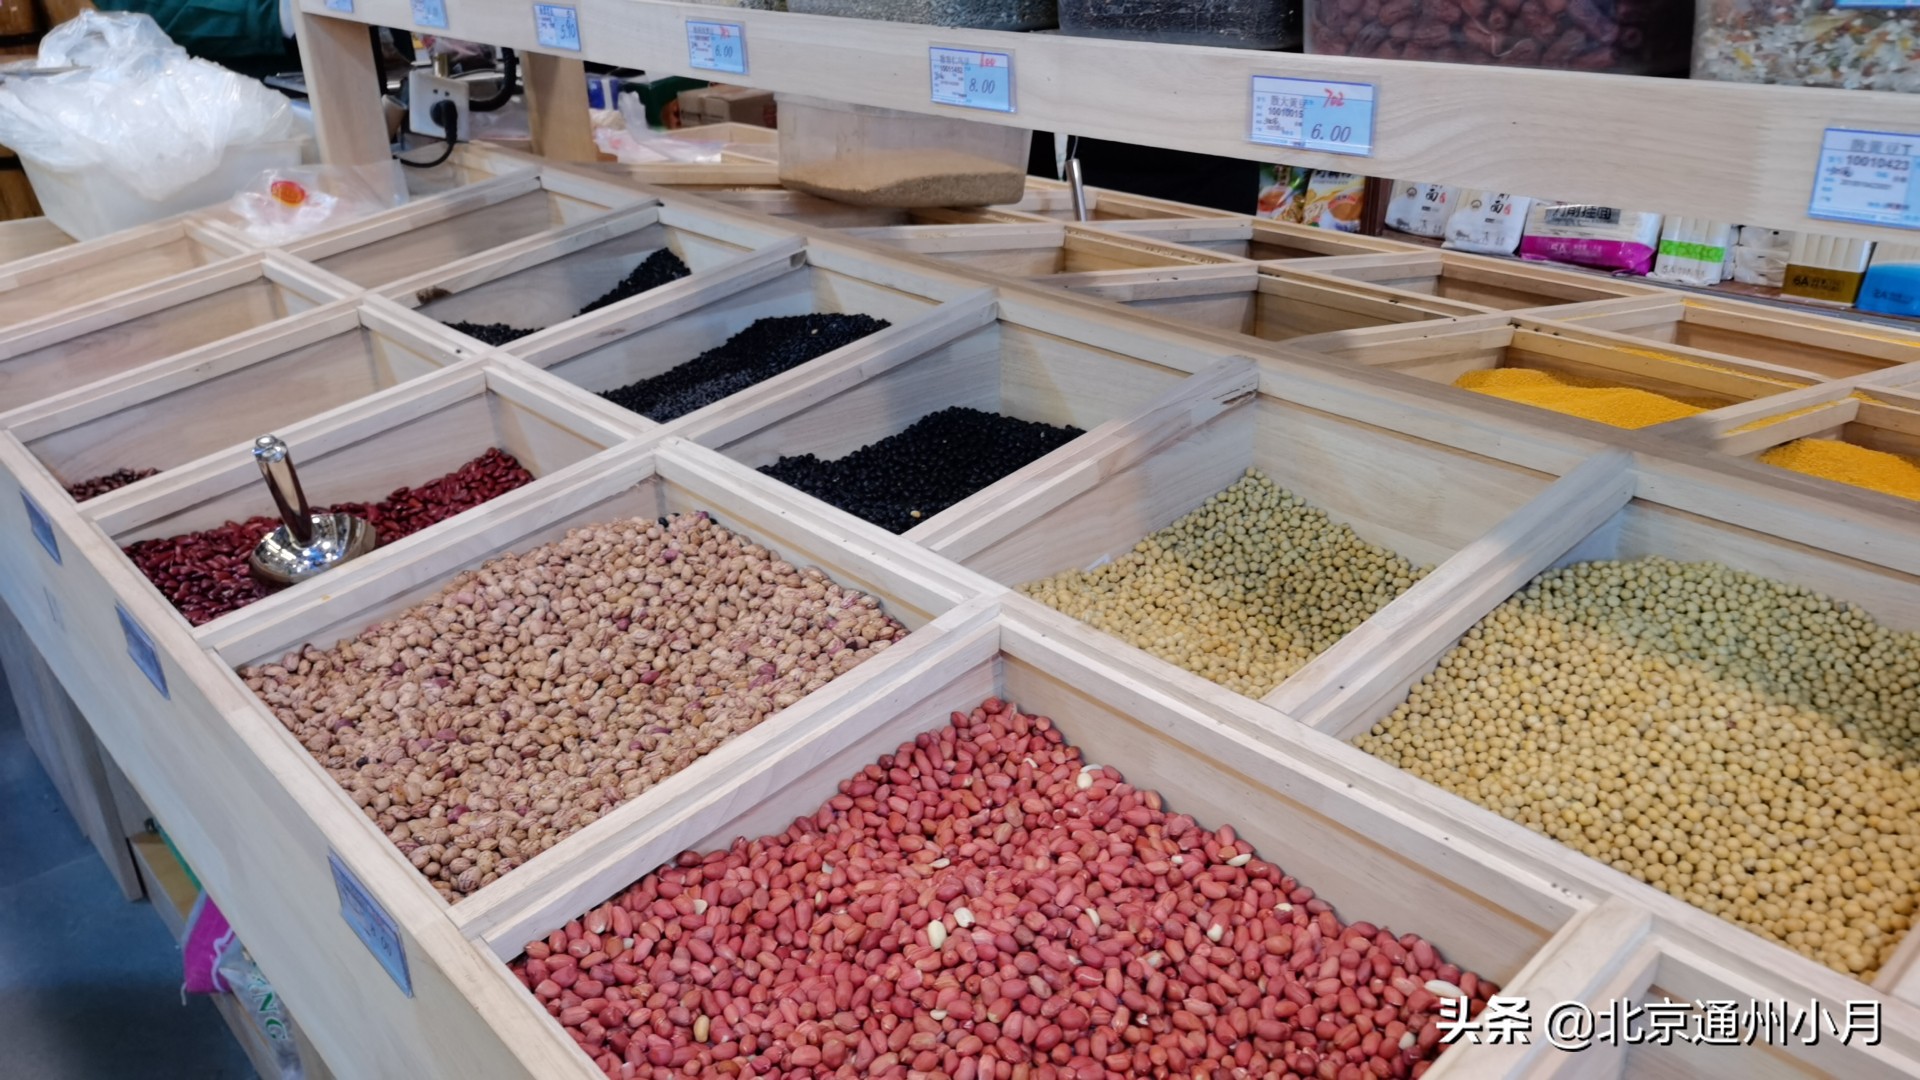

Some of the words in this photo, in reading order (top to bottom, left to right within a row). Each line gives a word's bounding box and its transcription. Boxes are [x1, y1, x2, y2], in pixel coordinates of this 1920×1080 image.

[715, 44, 733, 58] 6.00
[968, 78, 996, 95] 8.00
[1310, 123, 1352, 143] 6.00
